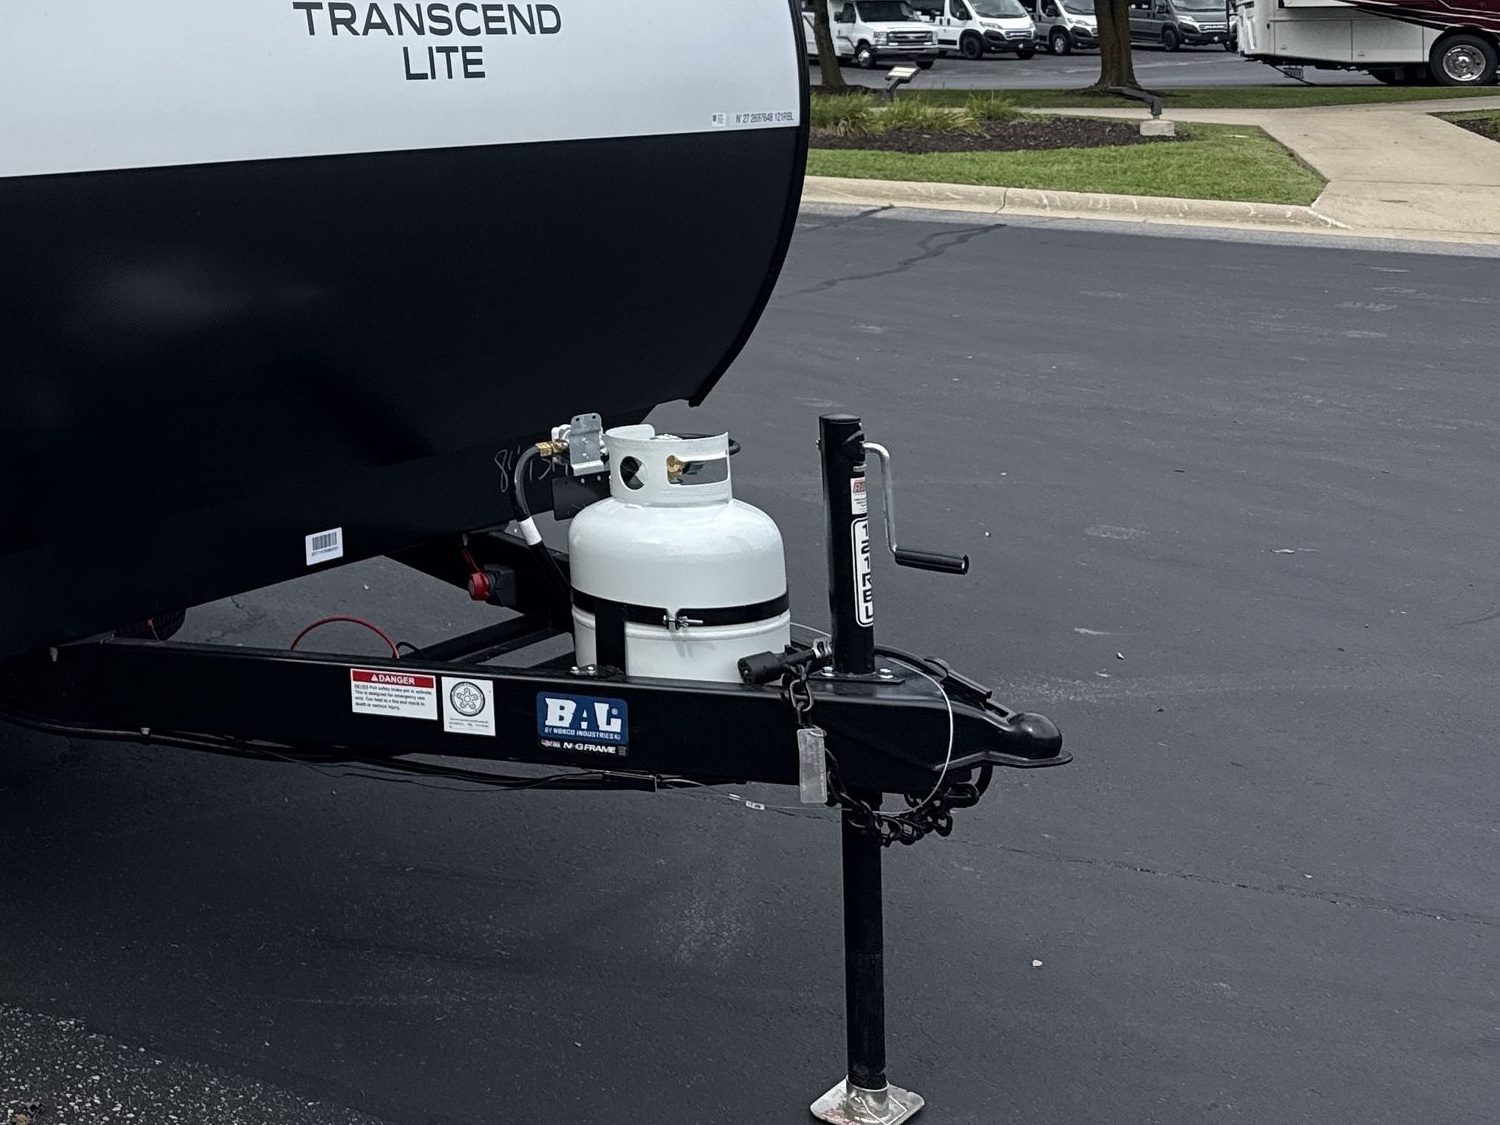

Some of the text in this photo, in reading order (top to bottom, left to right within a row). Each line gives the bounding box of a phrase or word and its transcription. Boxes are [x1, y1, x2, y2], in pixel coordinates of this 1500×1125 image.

[292, 1, 562, 37] TRANSCEND
[402, 45, 486, 81] LITE
[378, 674, 416, 685] DANGER
[545, 697, 622, 733] BAL
[544, 726, 614, 739] BY NORCO INDUSTRIES
[583, 743, 616, 754] FRAME
